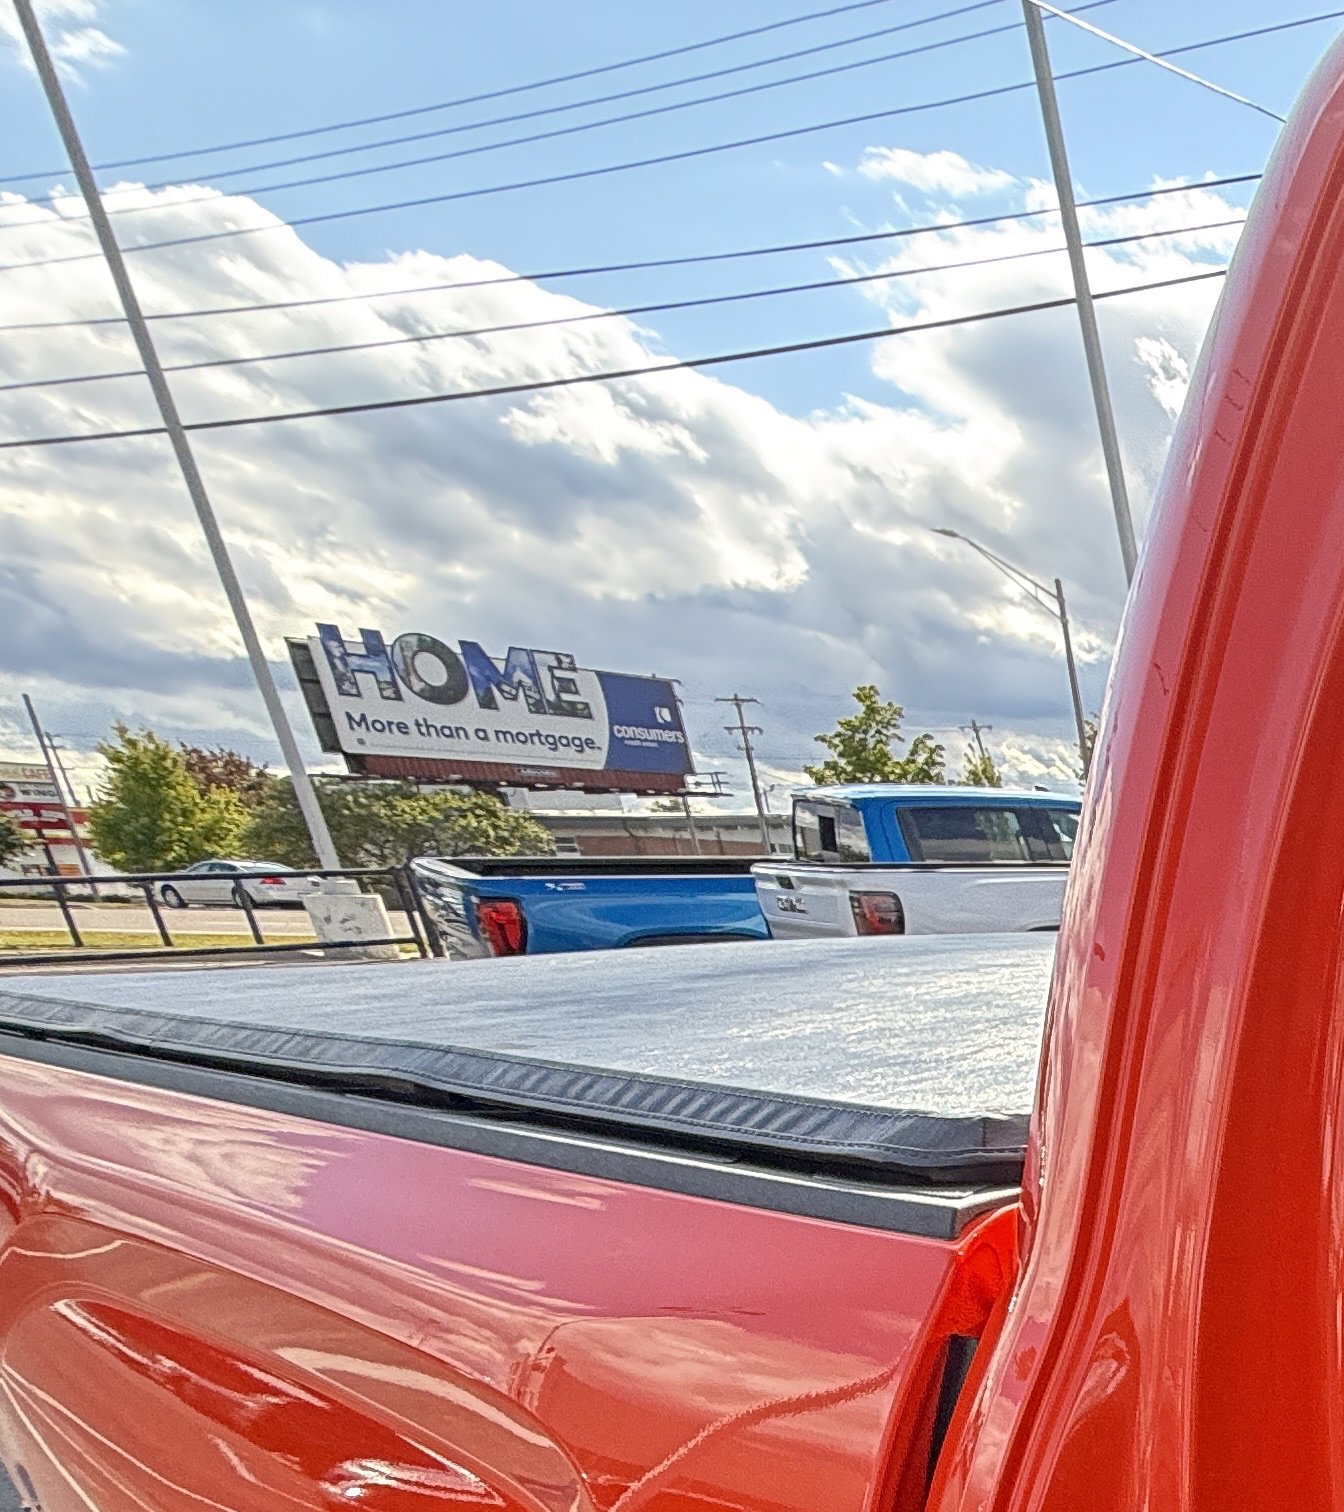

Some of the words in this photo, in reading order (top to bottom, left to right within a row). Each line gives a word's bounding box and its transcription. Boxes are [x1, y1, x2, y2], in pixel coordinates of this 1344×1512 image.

[315, 622, 595, 720] HOME
[344, 711, 410, 737] More
[414, 717, 469, 742] than
[474, 727, 490, 742] a
[493, 728, 603, 753] mortgage.
[613, 725, 685, 744] consumers
